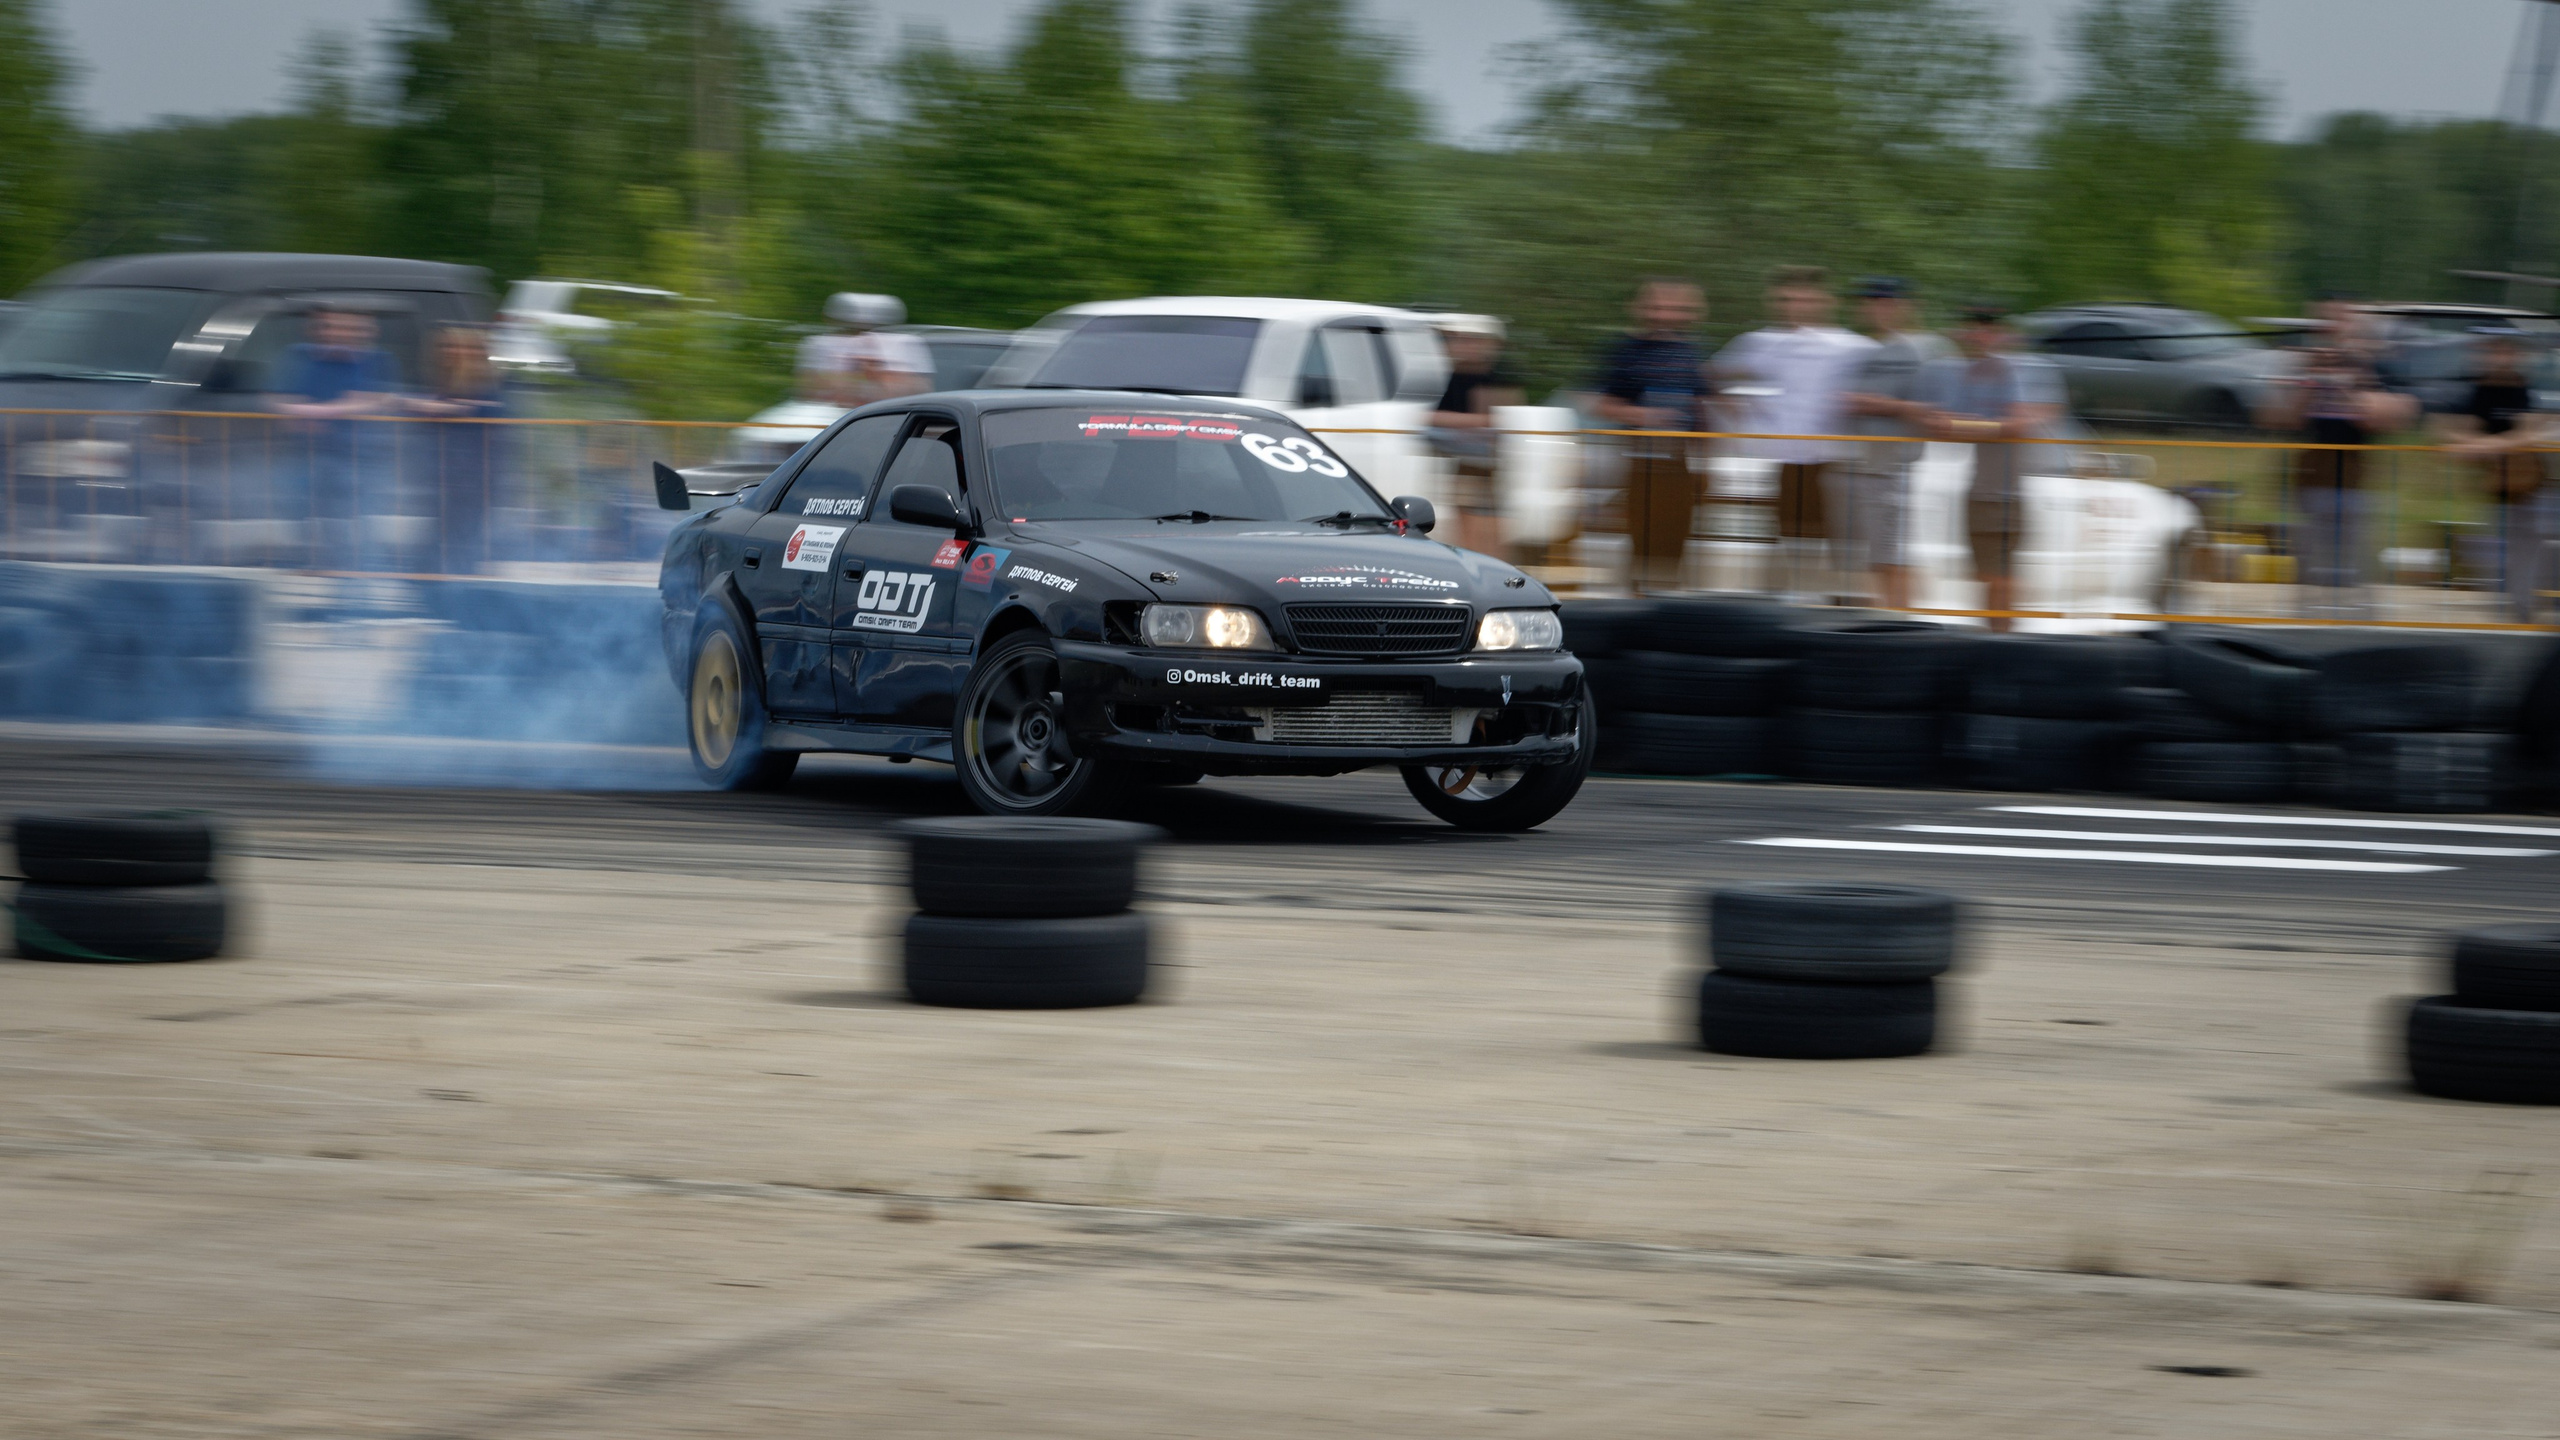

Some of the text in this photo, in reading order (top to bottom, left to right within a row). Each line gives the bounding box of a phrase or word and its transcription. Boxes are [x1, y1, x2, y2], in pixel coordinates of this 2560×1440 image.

[1241, 433, 1349, 478] 63
[802, 496, 866, 516] ДЯТЛОВ СЕРГЕЙ
[857, 569, 933, 613] ODT
[1008, 565, 1044, 583] ДЯТЛОВ
[1041, 573, 1079, 593] СЕРГЕЙ
[858, 615, 917, 630] OMSK DRIFT TEAM
[1184, 669, 1321, 688] Omsk_drift_team
